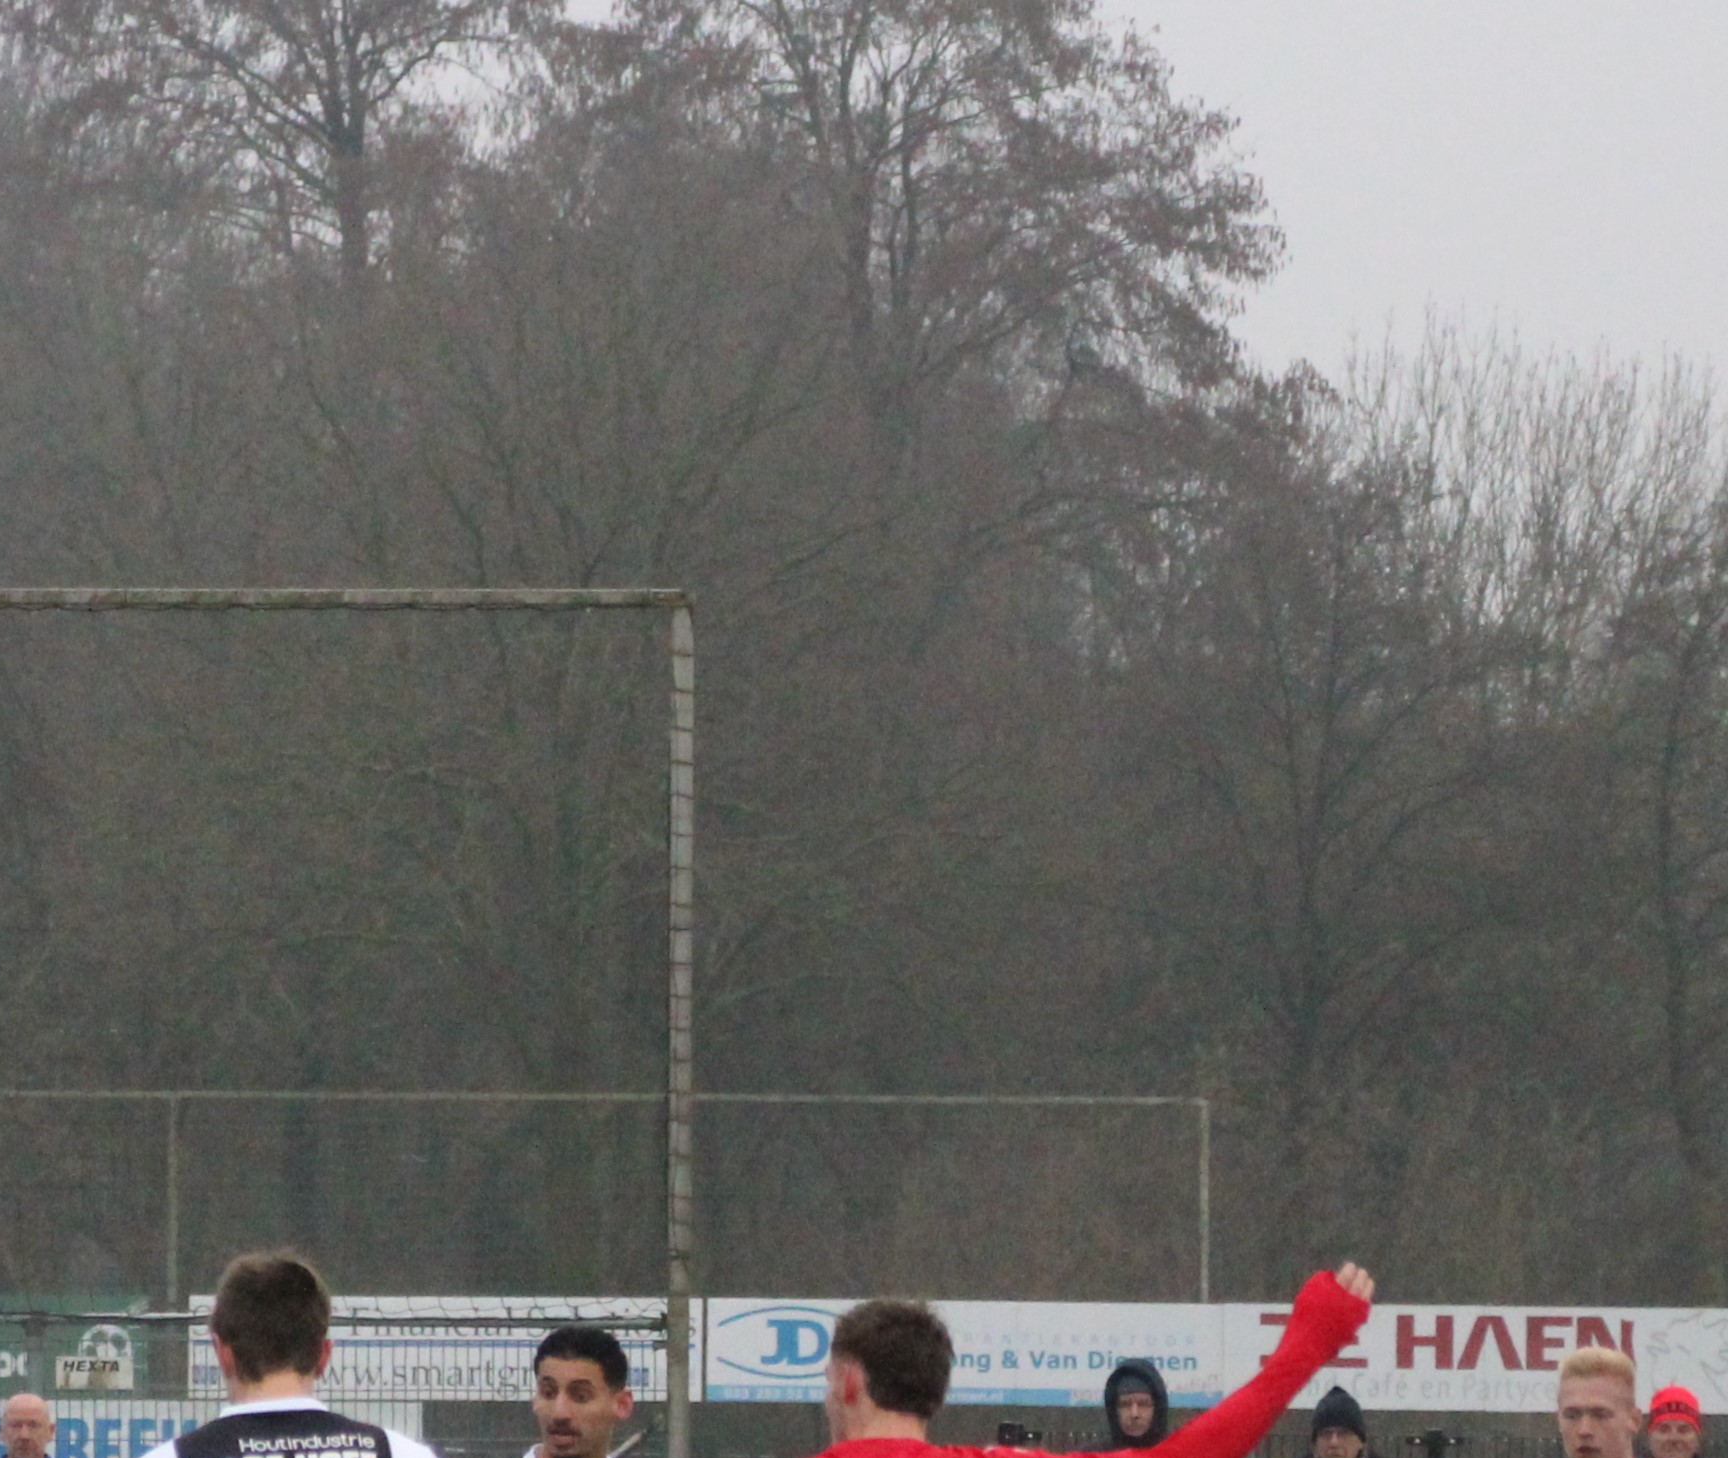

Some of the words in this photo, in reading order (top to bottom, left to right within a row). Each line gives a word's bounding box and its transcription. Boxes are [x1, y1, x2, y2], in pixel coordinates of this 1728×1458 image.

[759, 1319, 829, 1366] JD
[1001, 1350, 1019, 1369] &
[1029, 1350, 1078, 1369] Van
[238, 1433, 376, 1453] Houtindustrie
